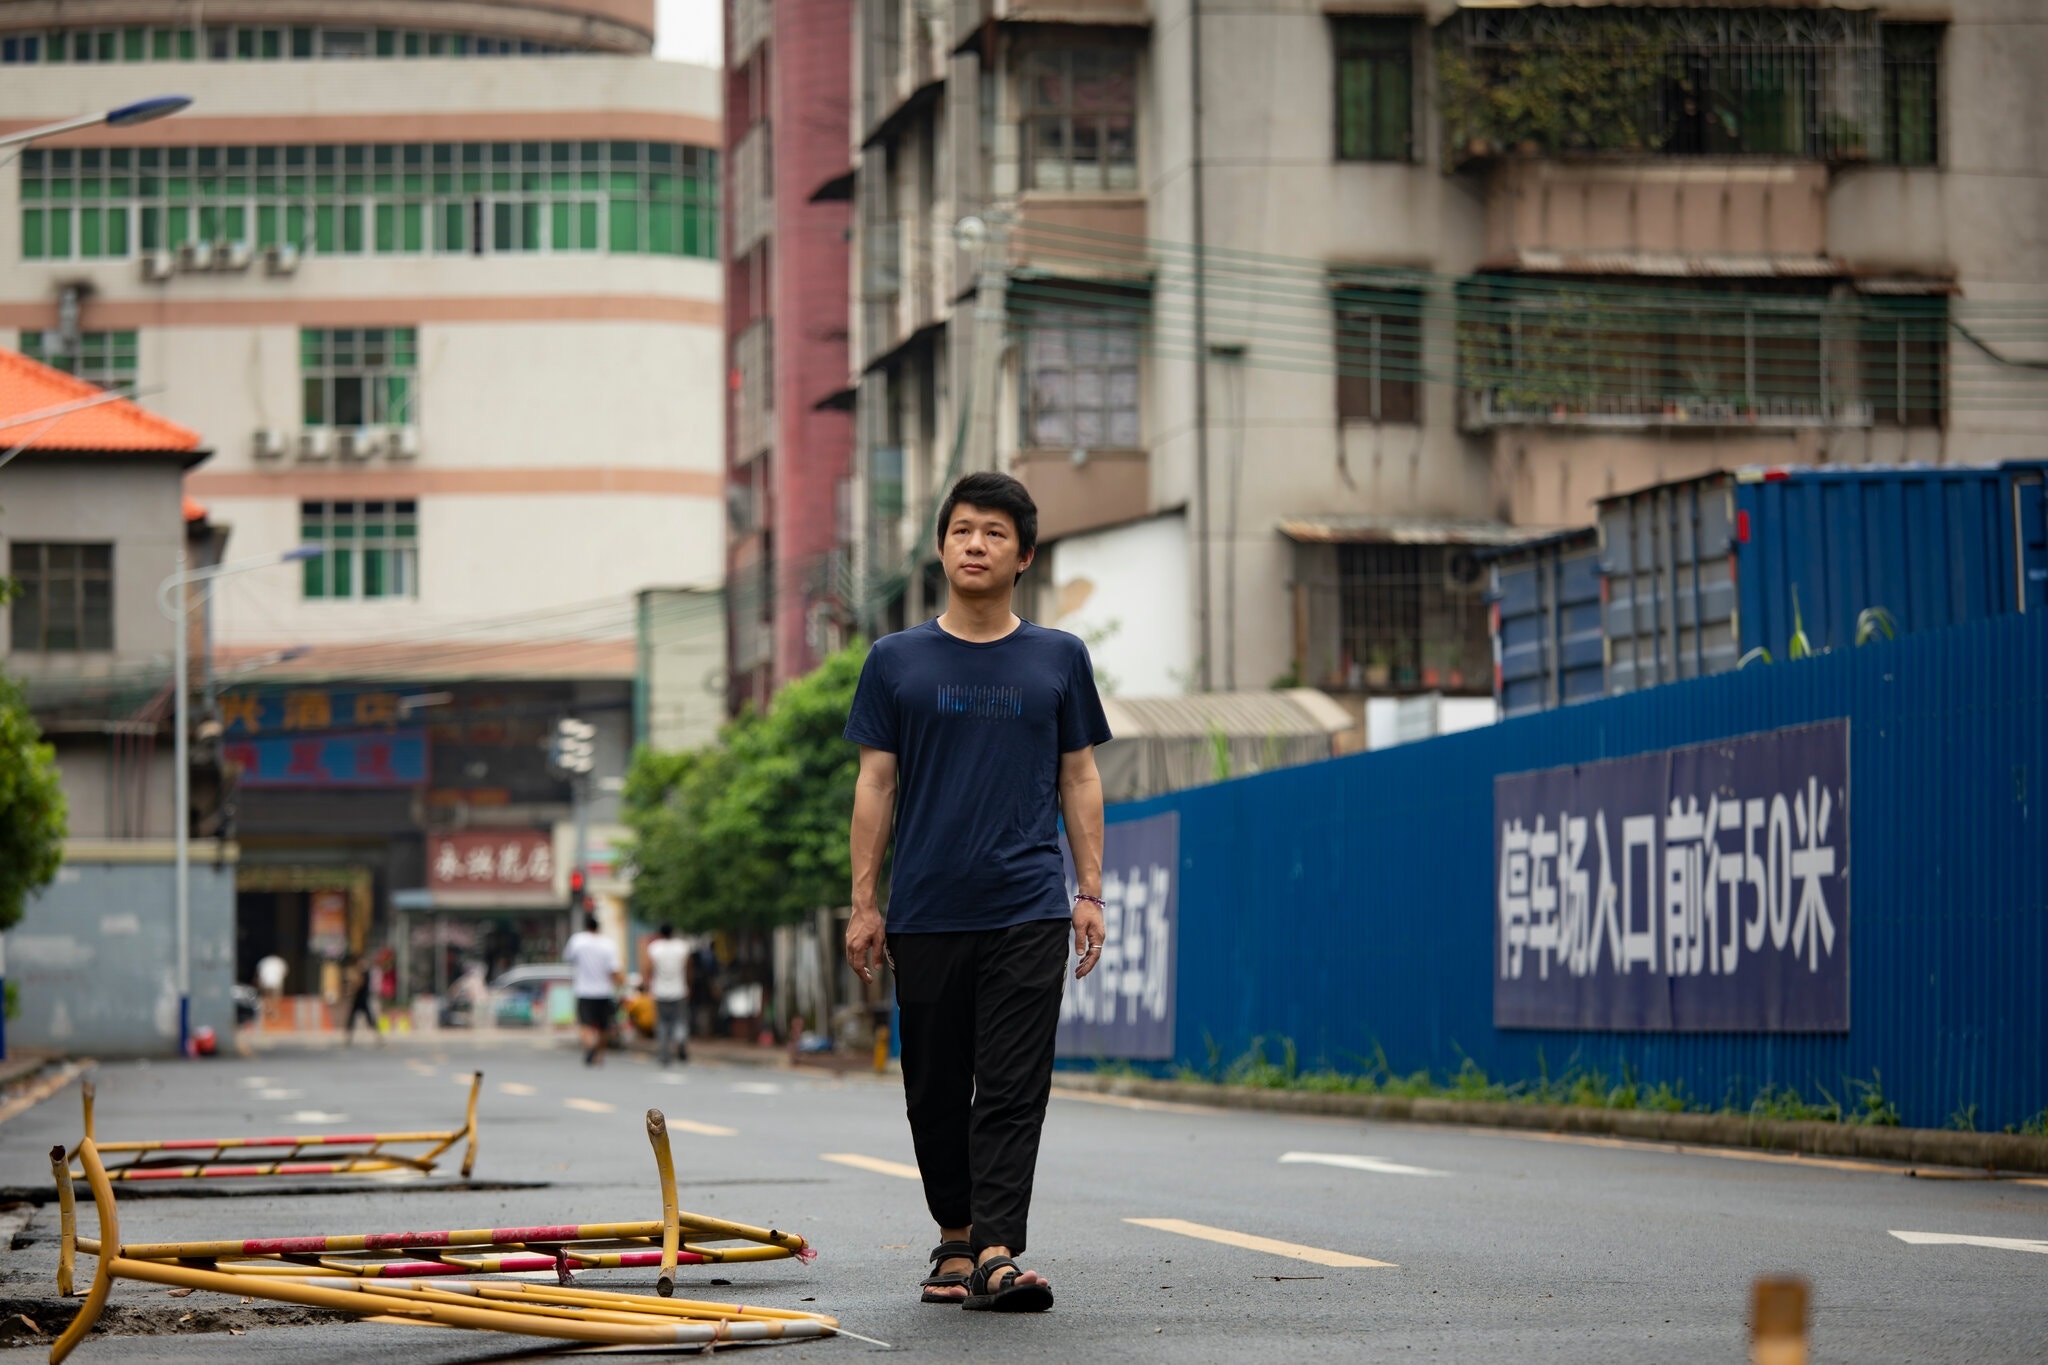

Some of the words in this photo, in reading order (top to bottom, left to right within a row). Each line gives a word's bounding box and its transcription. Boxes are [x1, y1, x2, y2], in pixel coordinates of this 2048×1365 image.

[1499, 776, 1836, 981] 停车场入口前行50米
